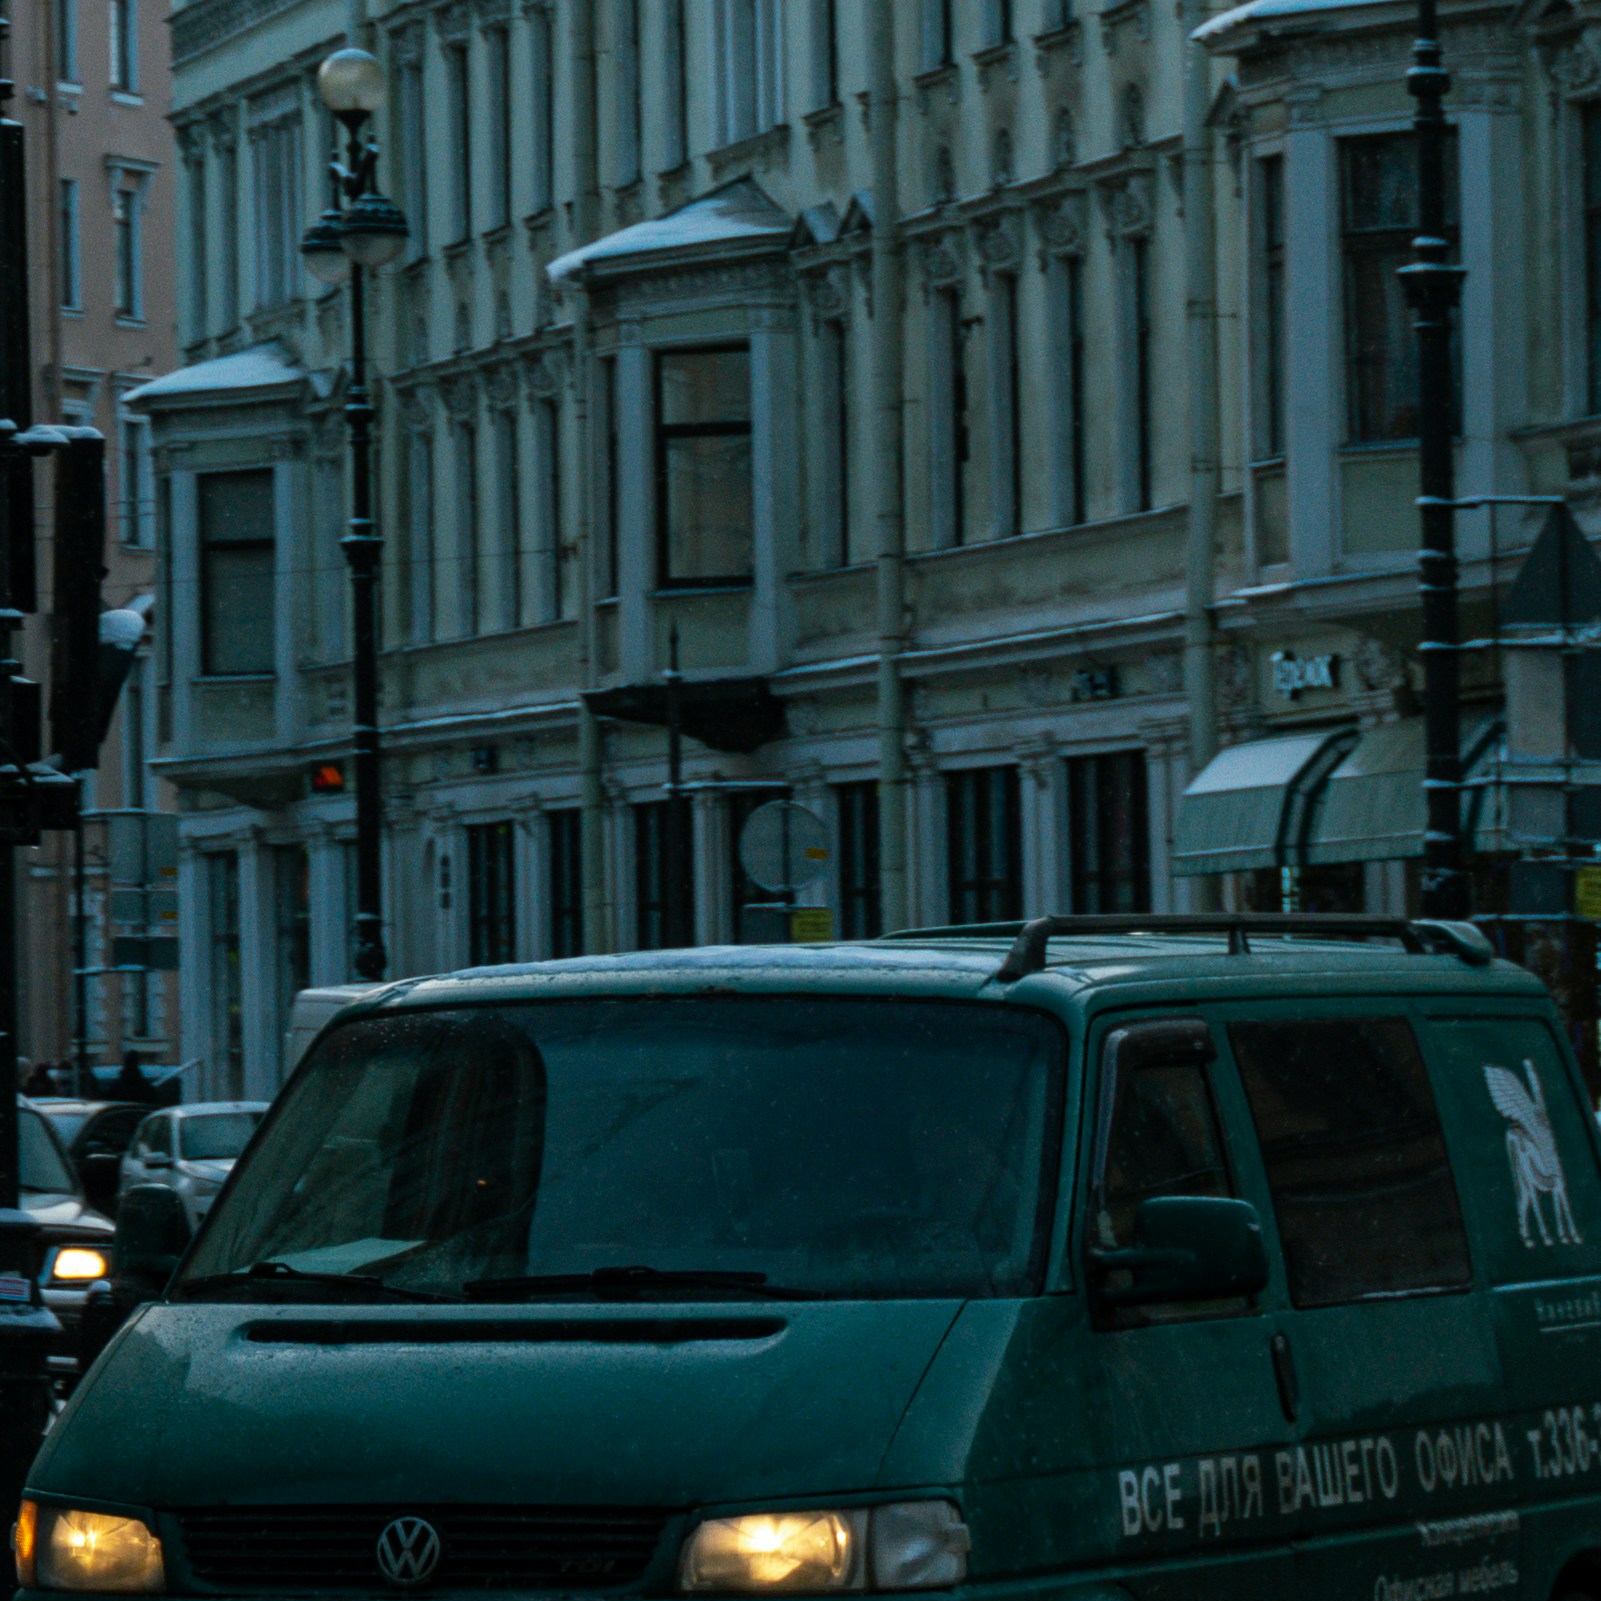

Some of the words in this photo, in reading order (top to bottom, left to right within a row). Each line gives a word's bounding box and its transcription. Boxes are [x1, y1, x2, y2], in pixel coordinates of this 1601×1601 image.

[1117, 1462, 1185, 1536] ВСЕ
[1198, 1454, 1264, 1537] ДЛЯ
[1275, 1436, 1399, 1515] ВАШЕГО
[1414, 1419, 1515, 1493] ОФИСА
